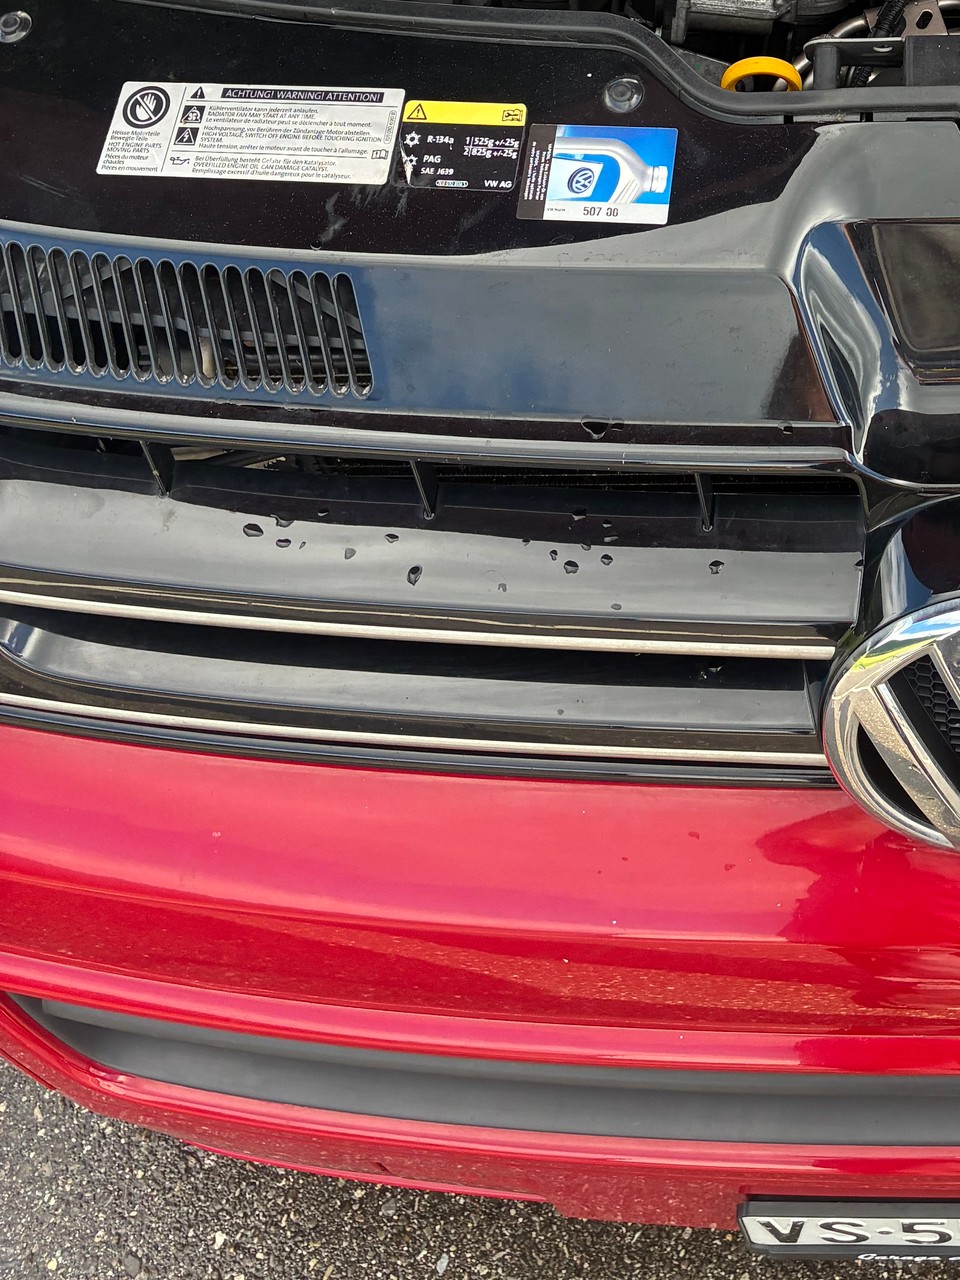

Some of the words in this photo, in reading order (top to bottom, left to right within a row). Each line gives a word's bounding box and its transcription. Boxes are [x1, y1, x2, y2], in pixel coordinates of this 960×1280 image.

[225, 89, 274, 98] ACHTUNG!
[277, 91, 324, 100] WARNING!
[326, 92, 380, 102] ATTENTION!
[427, 135, 454, 144] R-134a
[474, 137, 493, 147] 525g
[495, 139, 519, 148] +/-25g
[472, 148, 492, 158] 825g
[493, 149, 518, 159] +/-25g
[205, 155, 238, 163] Überfüllung
[423, 155, 441, 163] PAG
[583, 206, 602, 216] 507
[606, 208, 619, 217] 00
[858, 1254, 942, 1262] Garage
